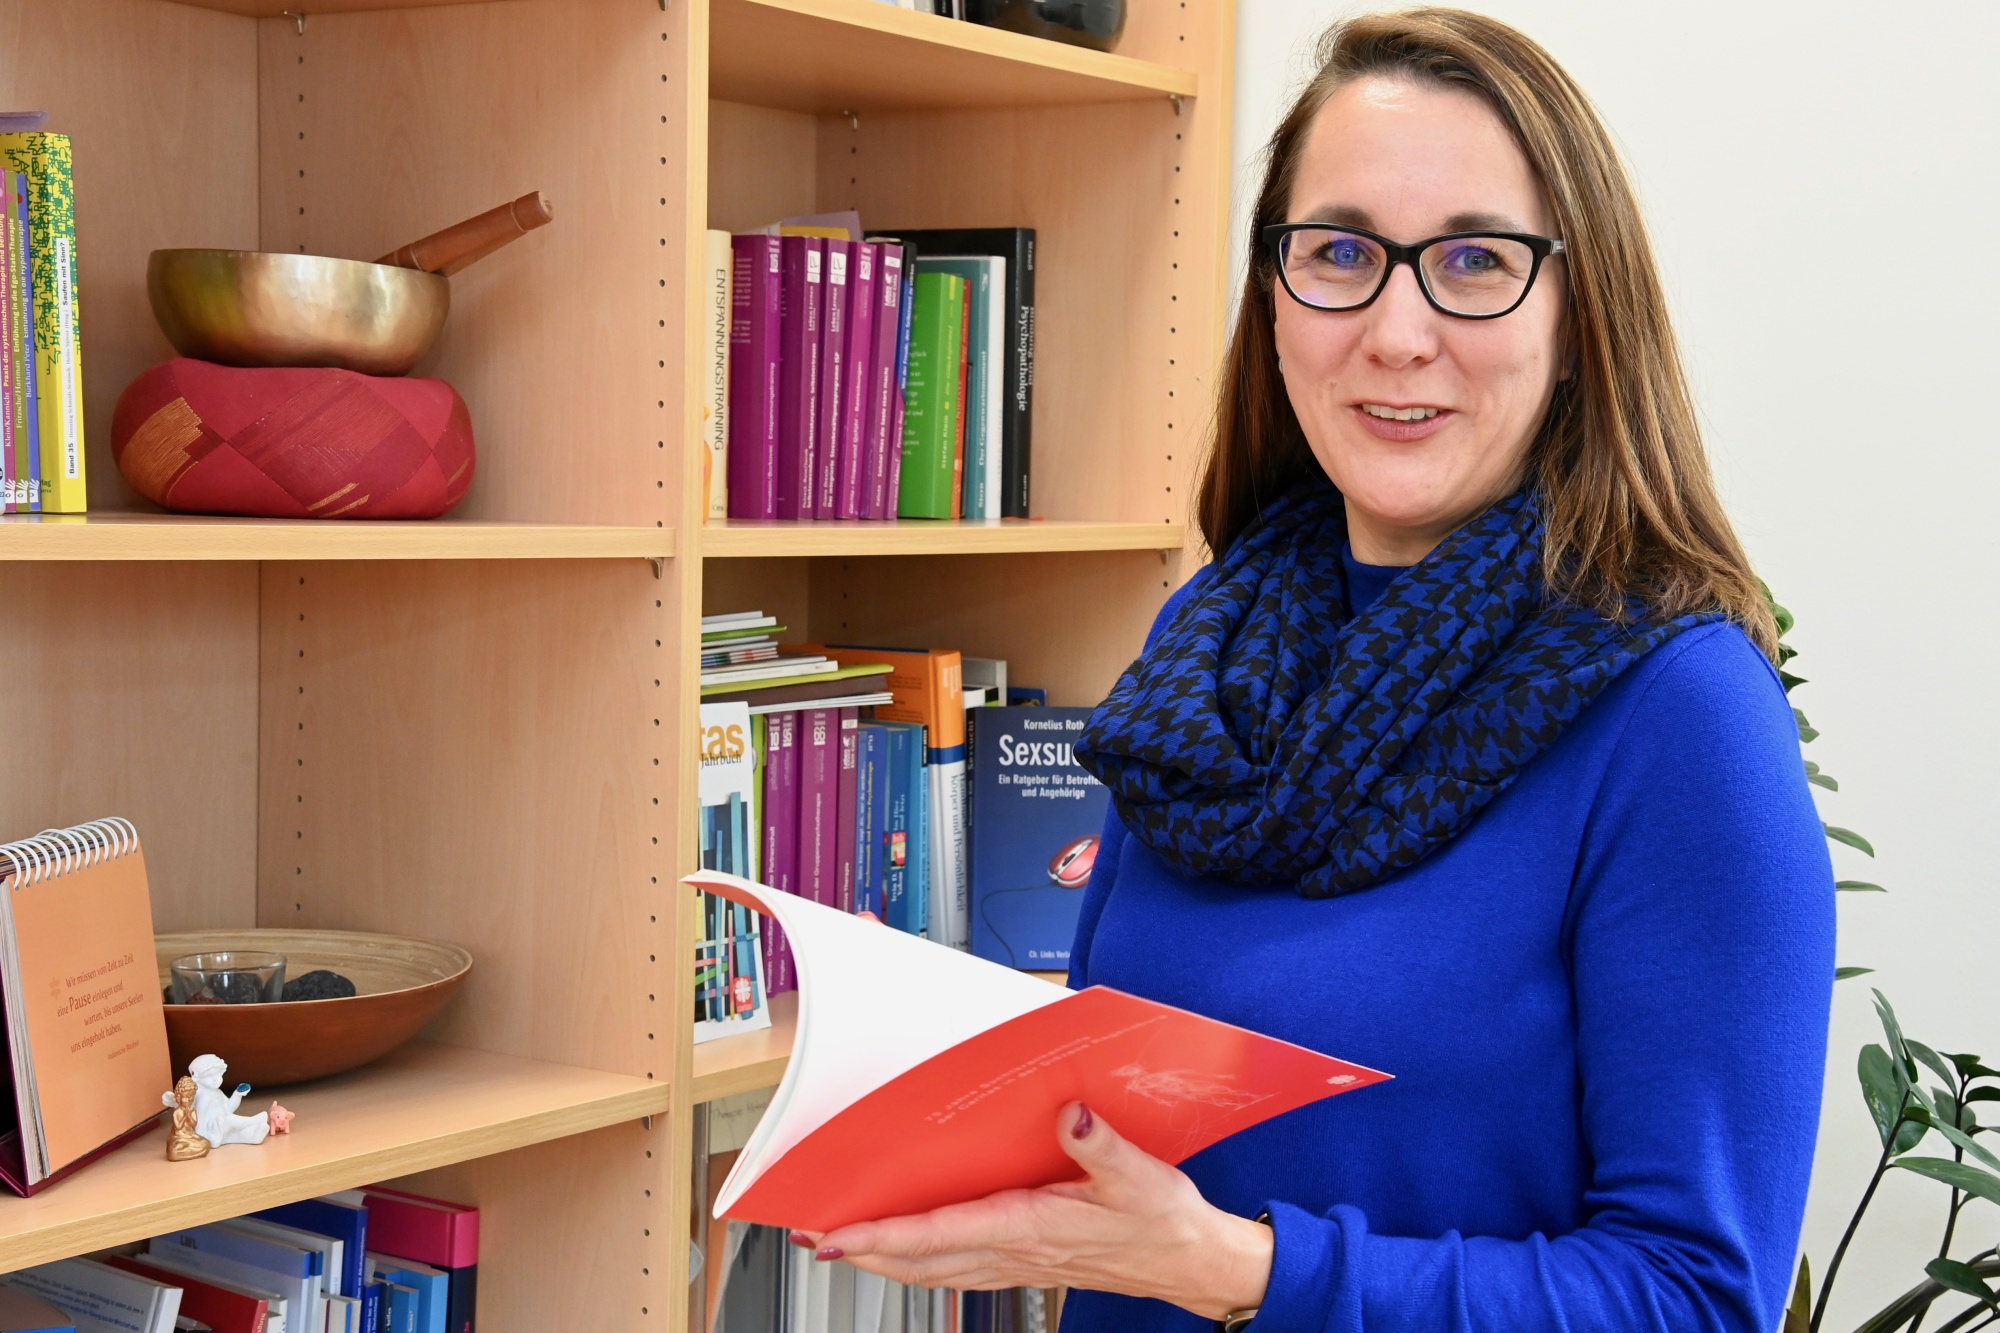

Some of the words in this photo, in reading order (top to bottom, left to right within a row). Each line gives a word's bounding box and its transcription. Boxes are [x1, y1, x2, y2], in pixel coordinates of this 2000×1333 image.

[8, 218, 18, 288] Ego-State-Therapie
[18, 220, 26, 275] Hypnotherapie
[59, 242, 67, 263] Sinn?
[0, 265, 8, 298] Therapie
[0, 299, 9, 349] systemischen
[905, 296, 913, 328] Selbstwert
[12, 312, 20, 352] Einführung
[2, 365, 10, 387] Praxis
[714, 268, 726, 451] ENTSPANNUNGSTRAINING
[1016, 306, 1029, 412] Psychopathologie
[13, 360, 23, 428] Fritzsche/Hartman
[24, 363, 32, 398] Burkhard
[768, 362, 776, 440] Entspannungstraining
[830, 365, 840, 458] Stressbewältigungsprogramm
[4, 392, 12, 447] Klein/Kannicht
[808, 396, 816, 450] Selbstakzeptanz,
[67, 443, 74, 453] 35
[828, 460, 836, 494] integrierte
[1024, 720, 1063, 730] Kornelius
[1066, 720, 1084, 730] Roth
[701, 750, 742, 770] Jahrbuch
[999, 734, 1080, 766] Sexsu
[950, 774, 961, 812] Körper
[998, 774, 1010, 784] Ein
[1013, 774, 1049, 786] Ratgeber
[1052, 774, 1064, 784] für
[1066, 775, 1103, 786] Betroffe
[1022, 788, 1036, 797] und
[1039, 787, 1085, 800] Angehörige
[814, 793, 822, 876] Gruppenpsychotherapie
[954, 814, 962, 835] und
[768, 826, 776, 873] Partnerschaft
[952, 837, 966, 912] Persönlichkeit
[66, 976, 76, 988] Wir
[77, 969, 97, 984] müssen
[97, 967, 107, 976] von
[107, 959, 117, 972] Zeit
[118, 959, 124, 968] zu
[124, 953, 134, 965] Zeit
[57, 1006, 69, 1017] eine
[69, 992, 91, 1012] Pause
[92, 986, 113, 1001] einlegen
[114, 980, 124, 994] und
[84, 1012, 104, 1026] warten,
[112, 1001, 128, 1014] unsere
[128, 993, 144, 1007] Seelen
[71, 1041, 81, 1053] uns
[82, 1029, 105, 1048] eingeholt
[106, 1023, 122, 1037] haben.
[937, 1112, 956, 1124] der
[958, 1085, 1002, 1110] Caritas
[1003, 1077, 1015, 1086] in
[1018, 1067, 1038, 1078] der
[945, 1090, 978, 1109] Jahre
